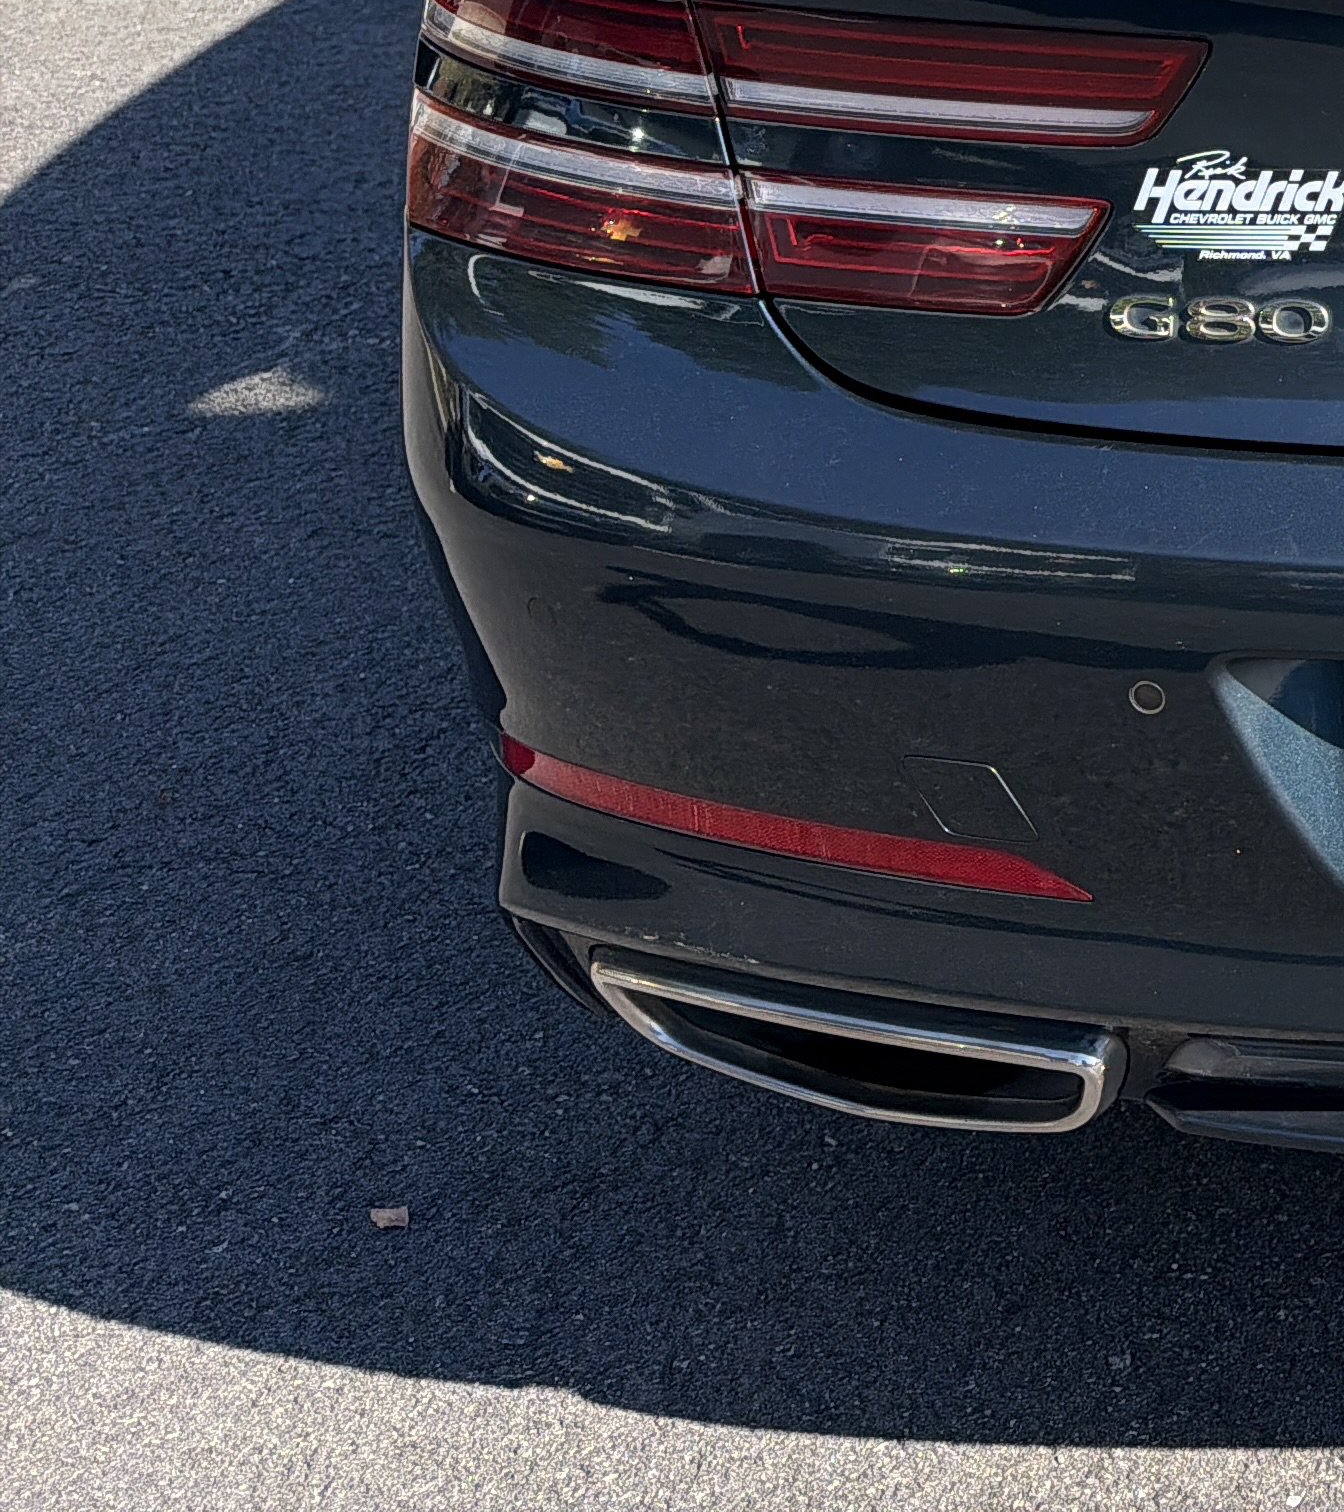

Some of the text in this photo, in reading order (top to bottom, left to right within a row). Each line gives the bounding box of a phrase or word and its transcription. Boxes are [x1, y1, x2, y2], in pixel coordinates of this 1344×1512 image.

[1176, 150, 1248, 180] Rick
[1169, 213, 1337, 225] CHEVROLET BUICK GMC
[1271, 250, 1292, 261] VA
[1109, 294, 1330, 343] G80
